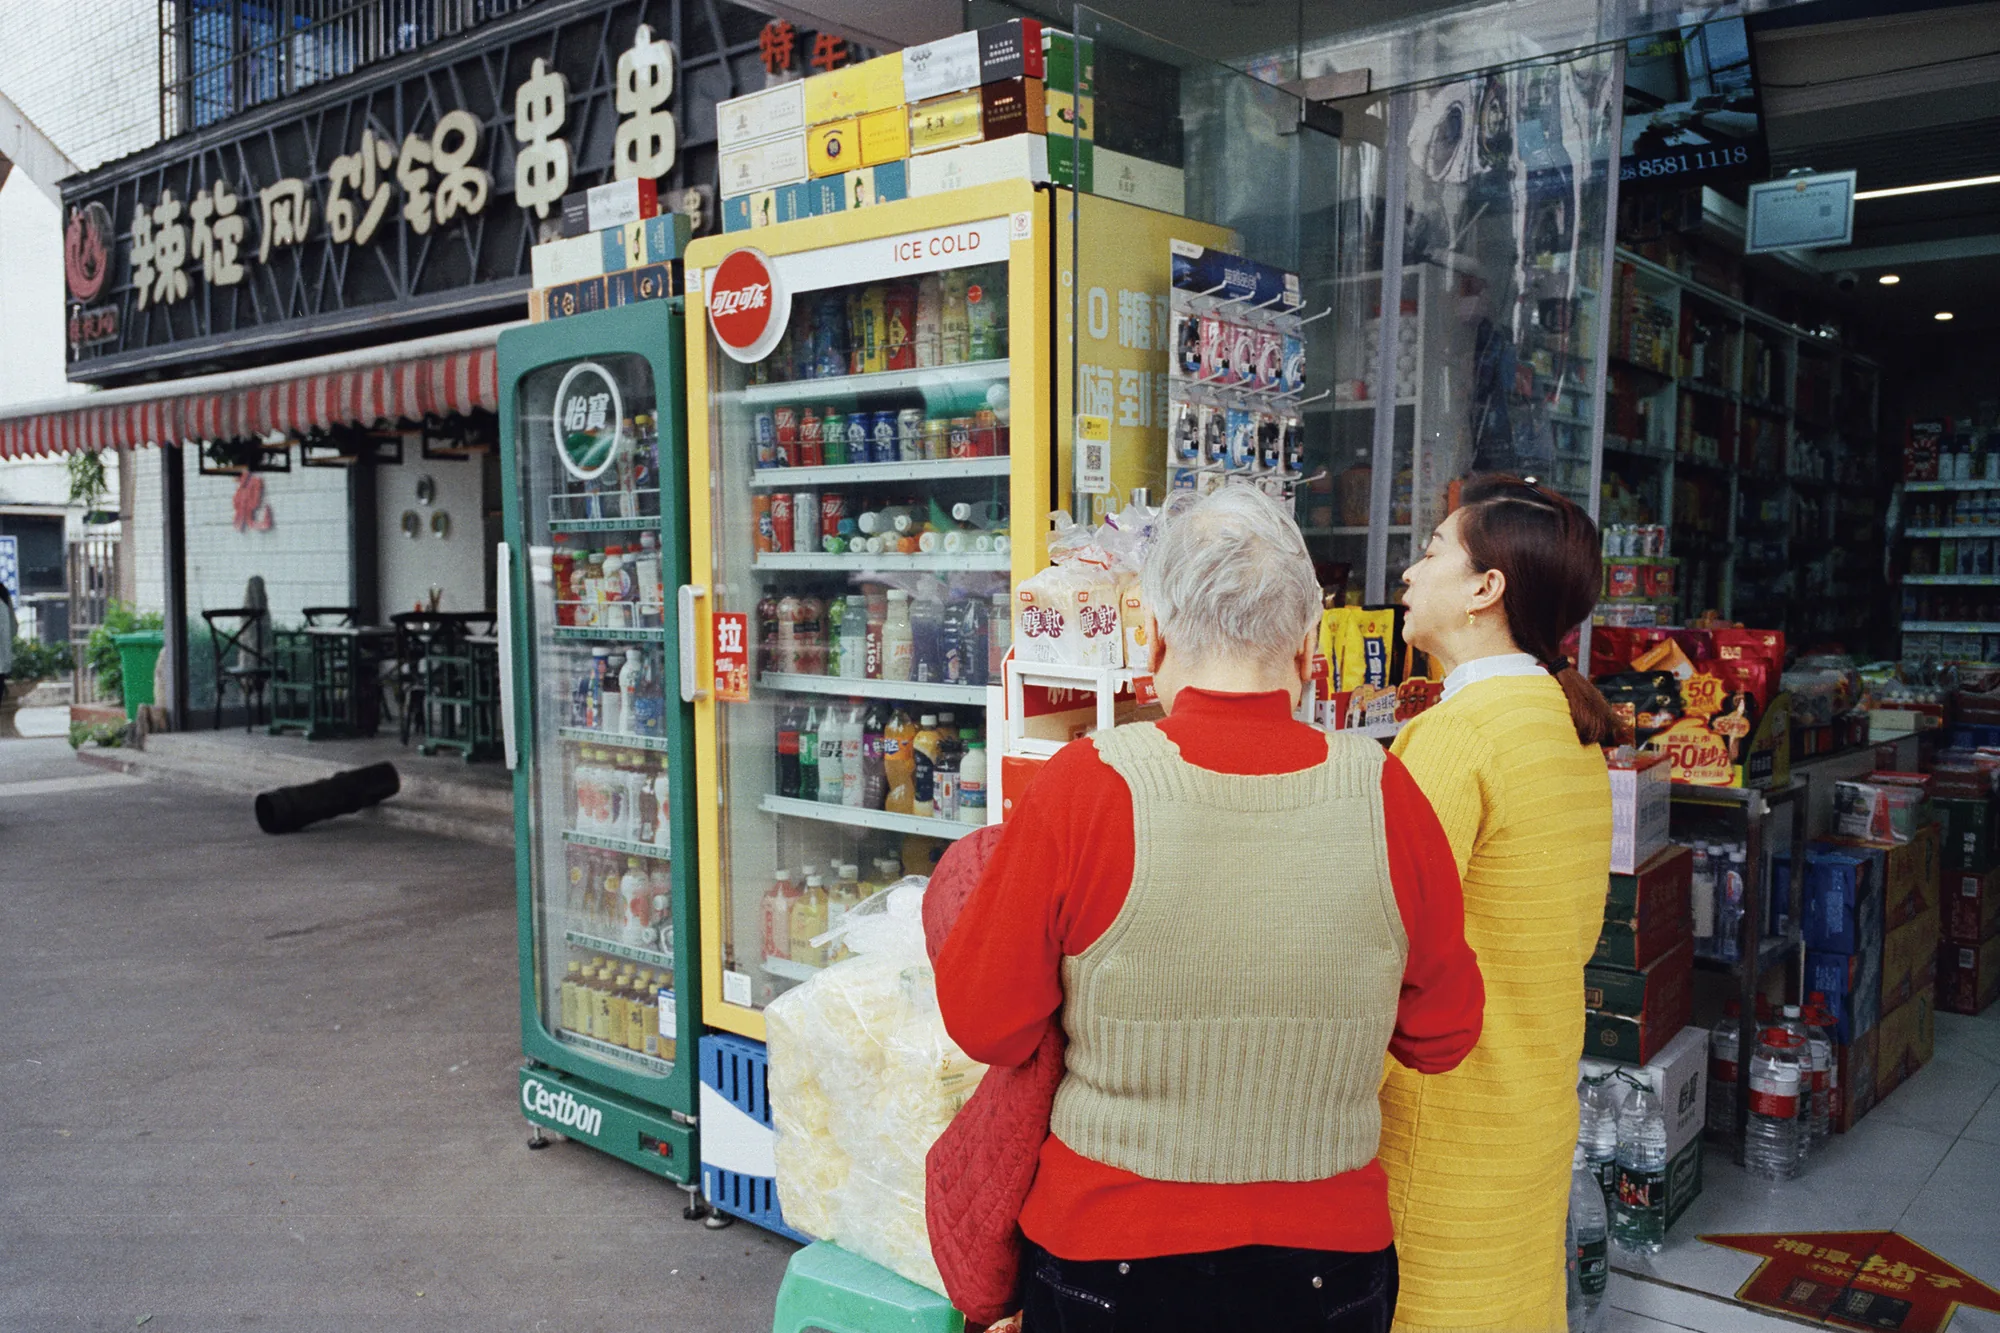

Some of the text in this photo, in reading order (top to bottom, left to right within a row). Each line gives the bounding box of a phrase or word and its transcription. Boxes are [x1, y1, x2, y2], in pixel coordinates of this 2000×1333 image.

[1619, 146, 1749, 181] 28 8581 1118
[894, 231, 982, 263] ICE COLD
[712, 281, 771, 318] 可口可乐
[717, 616, 743, 654] 拉
[867, 633, 875, 673] COSTA
[1688, 680, 1716, 698] 50
[522, 1079, 603, 1137] C'estbon
